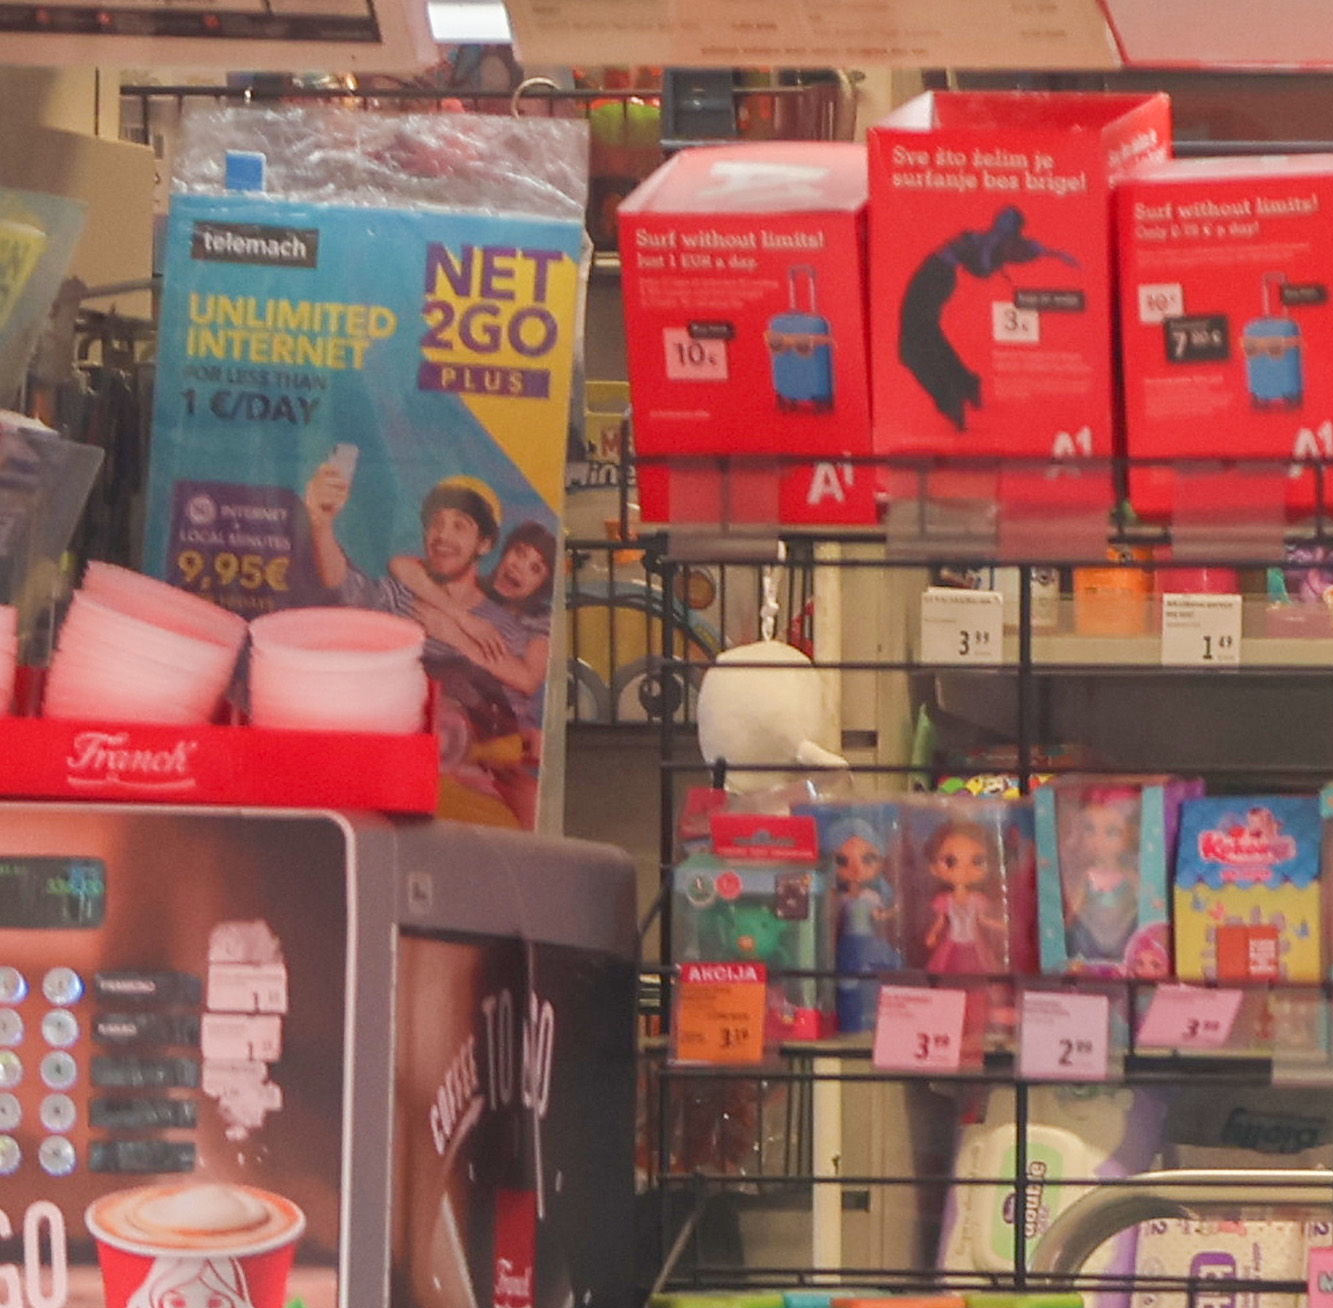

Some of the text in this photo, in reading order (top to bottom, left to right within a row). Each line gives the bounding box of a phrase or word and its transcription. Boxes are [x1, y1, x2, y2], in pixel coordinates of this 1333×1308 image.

[893, 146, 1053, 174] Sve što želim je
[893, 170, 1086, 195] surfanje bez brige!
[1135, 193, 1319, 222] Surf without limits!
[203, 231, 306, 260] telemach
[636, 229, 824, 249] Surf without limits!
[425, 241, 566, 304] NET
[189, 293, 396, 338] UNLIMITED
[420, 303, 558, 358] 2GO
[186, 332, 371, 371] INTERNET
[440, 367, 524, 396] PLUS
[181, 388, 321, 426] 1 €/DAY
[178, 550, 290, 592] 9,95€
[67, 731, 198, 776] Franck
[688, 964, 758, 984] AKCIJA
